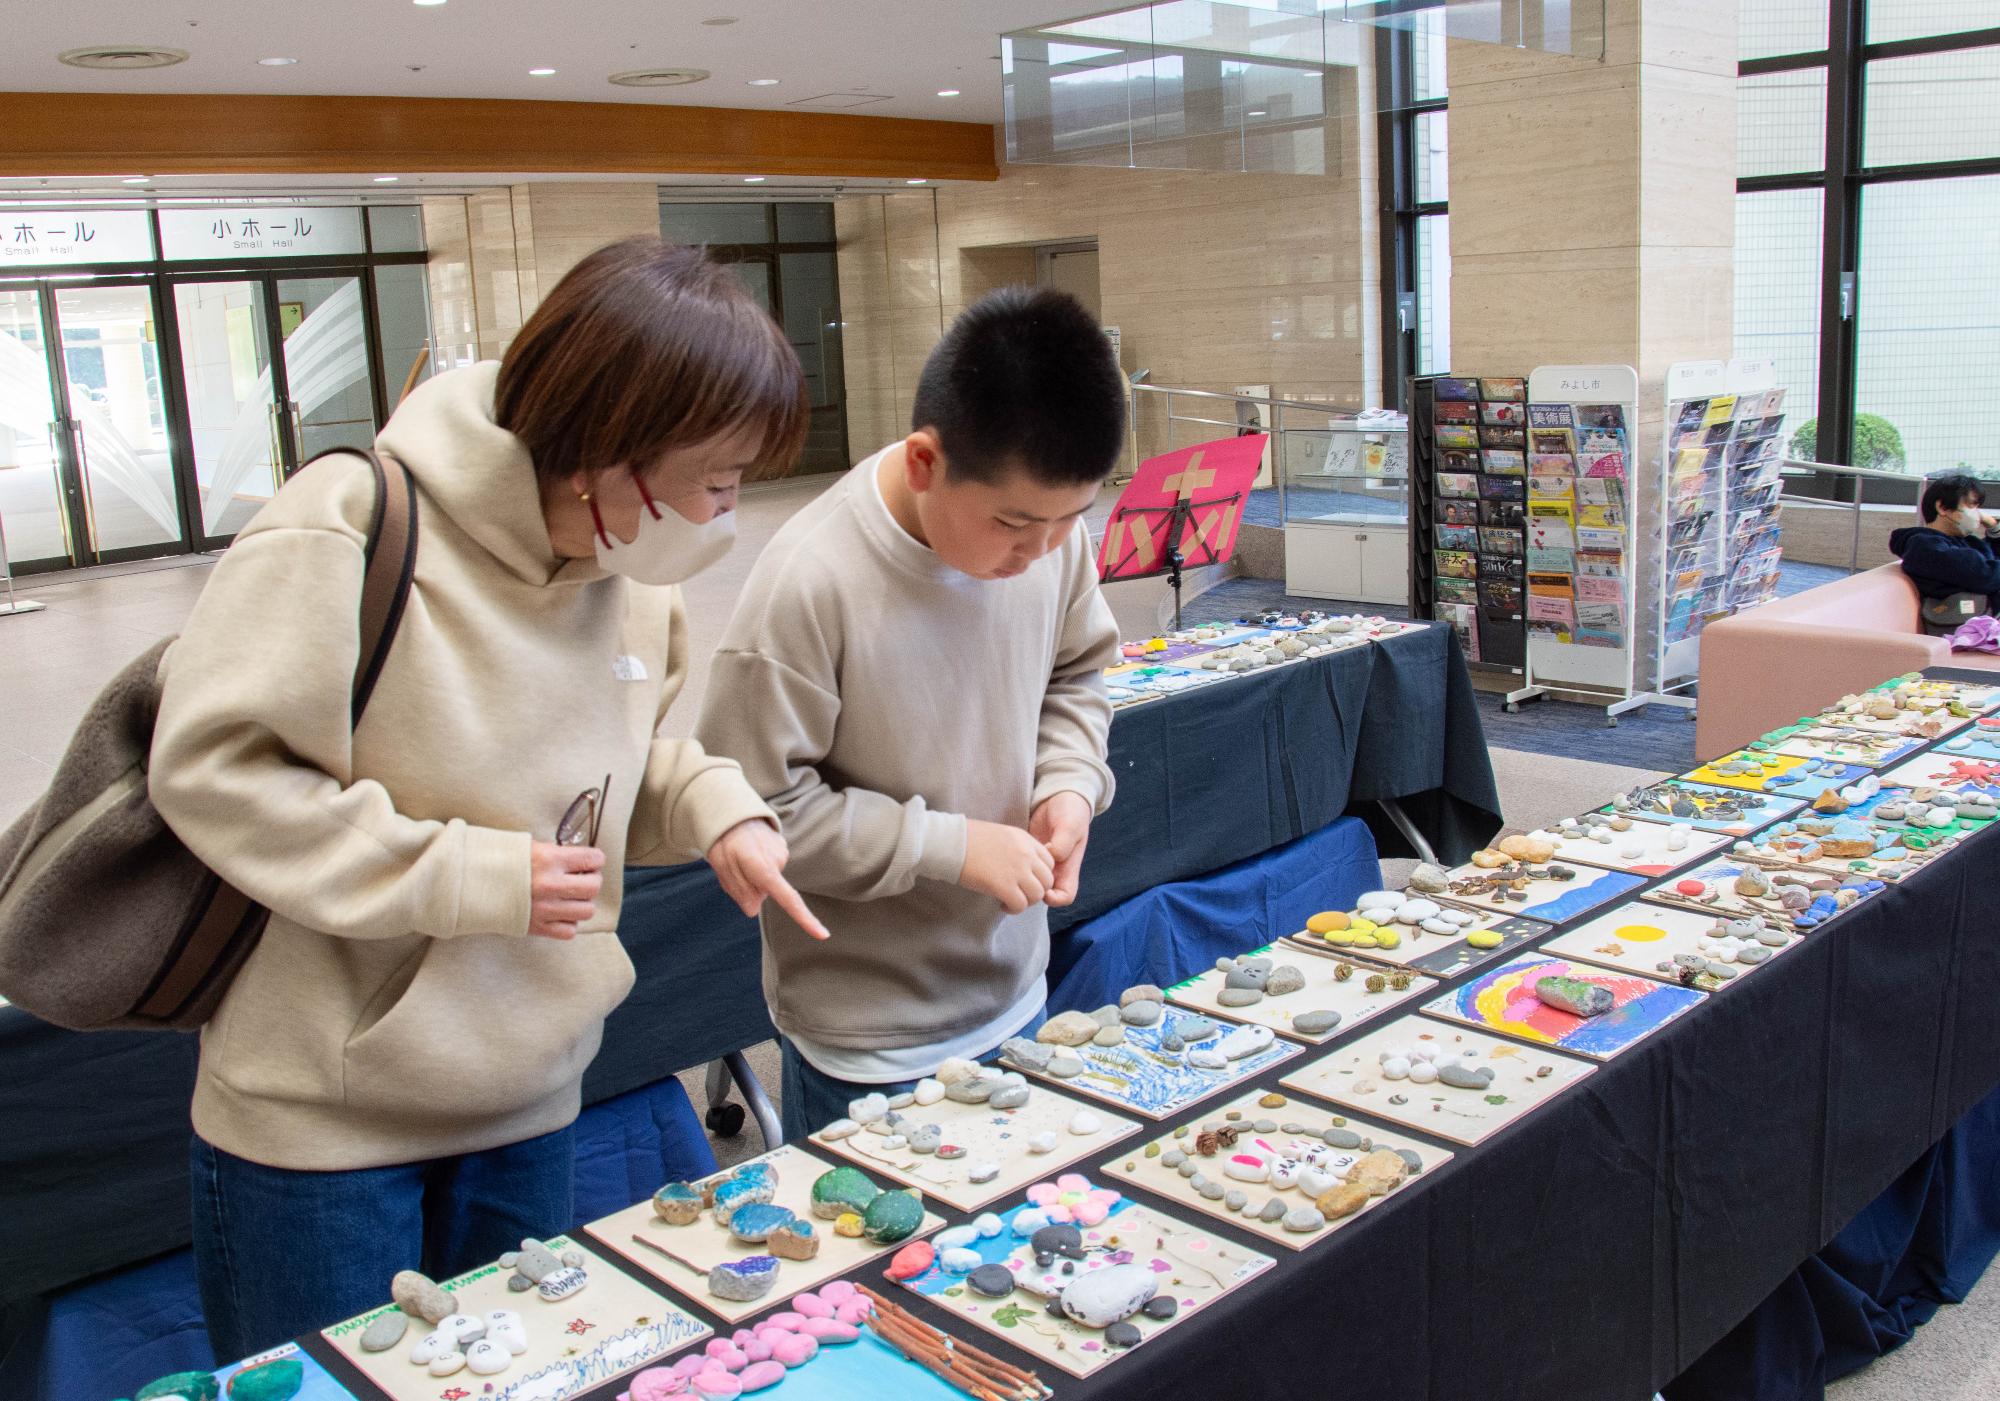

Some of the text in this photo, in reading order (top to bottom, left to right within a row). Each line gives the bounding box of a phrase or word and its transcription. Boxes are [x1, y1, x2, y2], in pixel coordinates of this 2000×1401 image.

[0, 221, 96, 243] ホール
[212, 217, 312, 239] 小ホール
[233, 239, 293, 249] Small Hall
[5, 246, 74, 256] Small Hall
[1560, 378, 1601, 390] みよし市
[1533, 411, 1573, 425] 美術展
